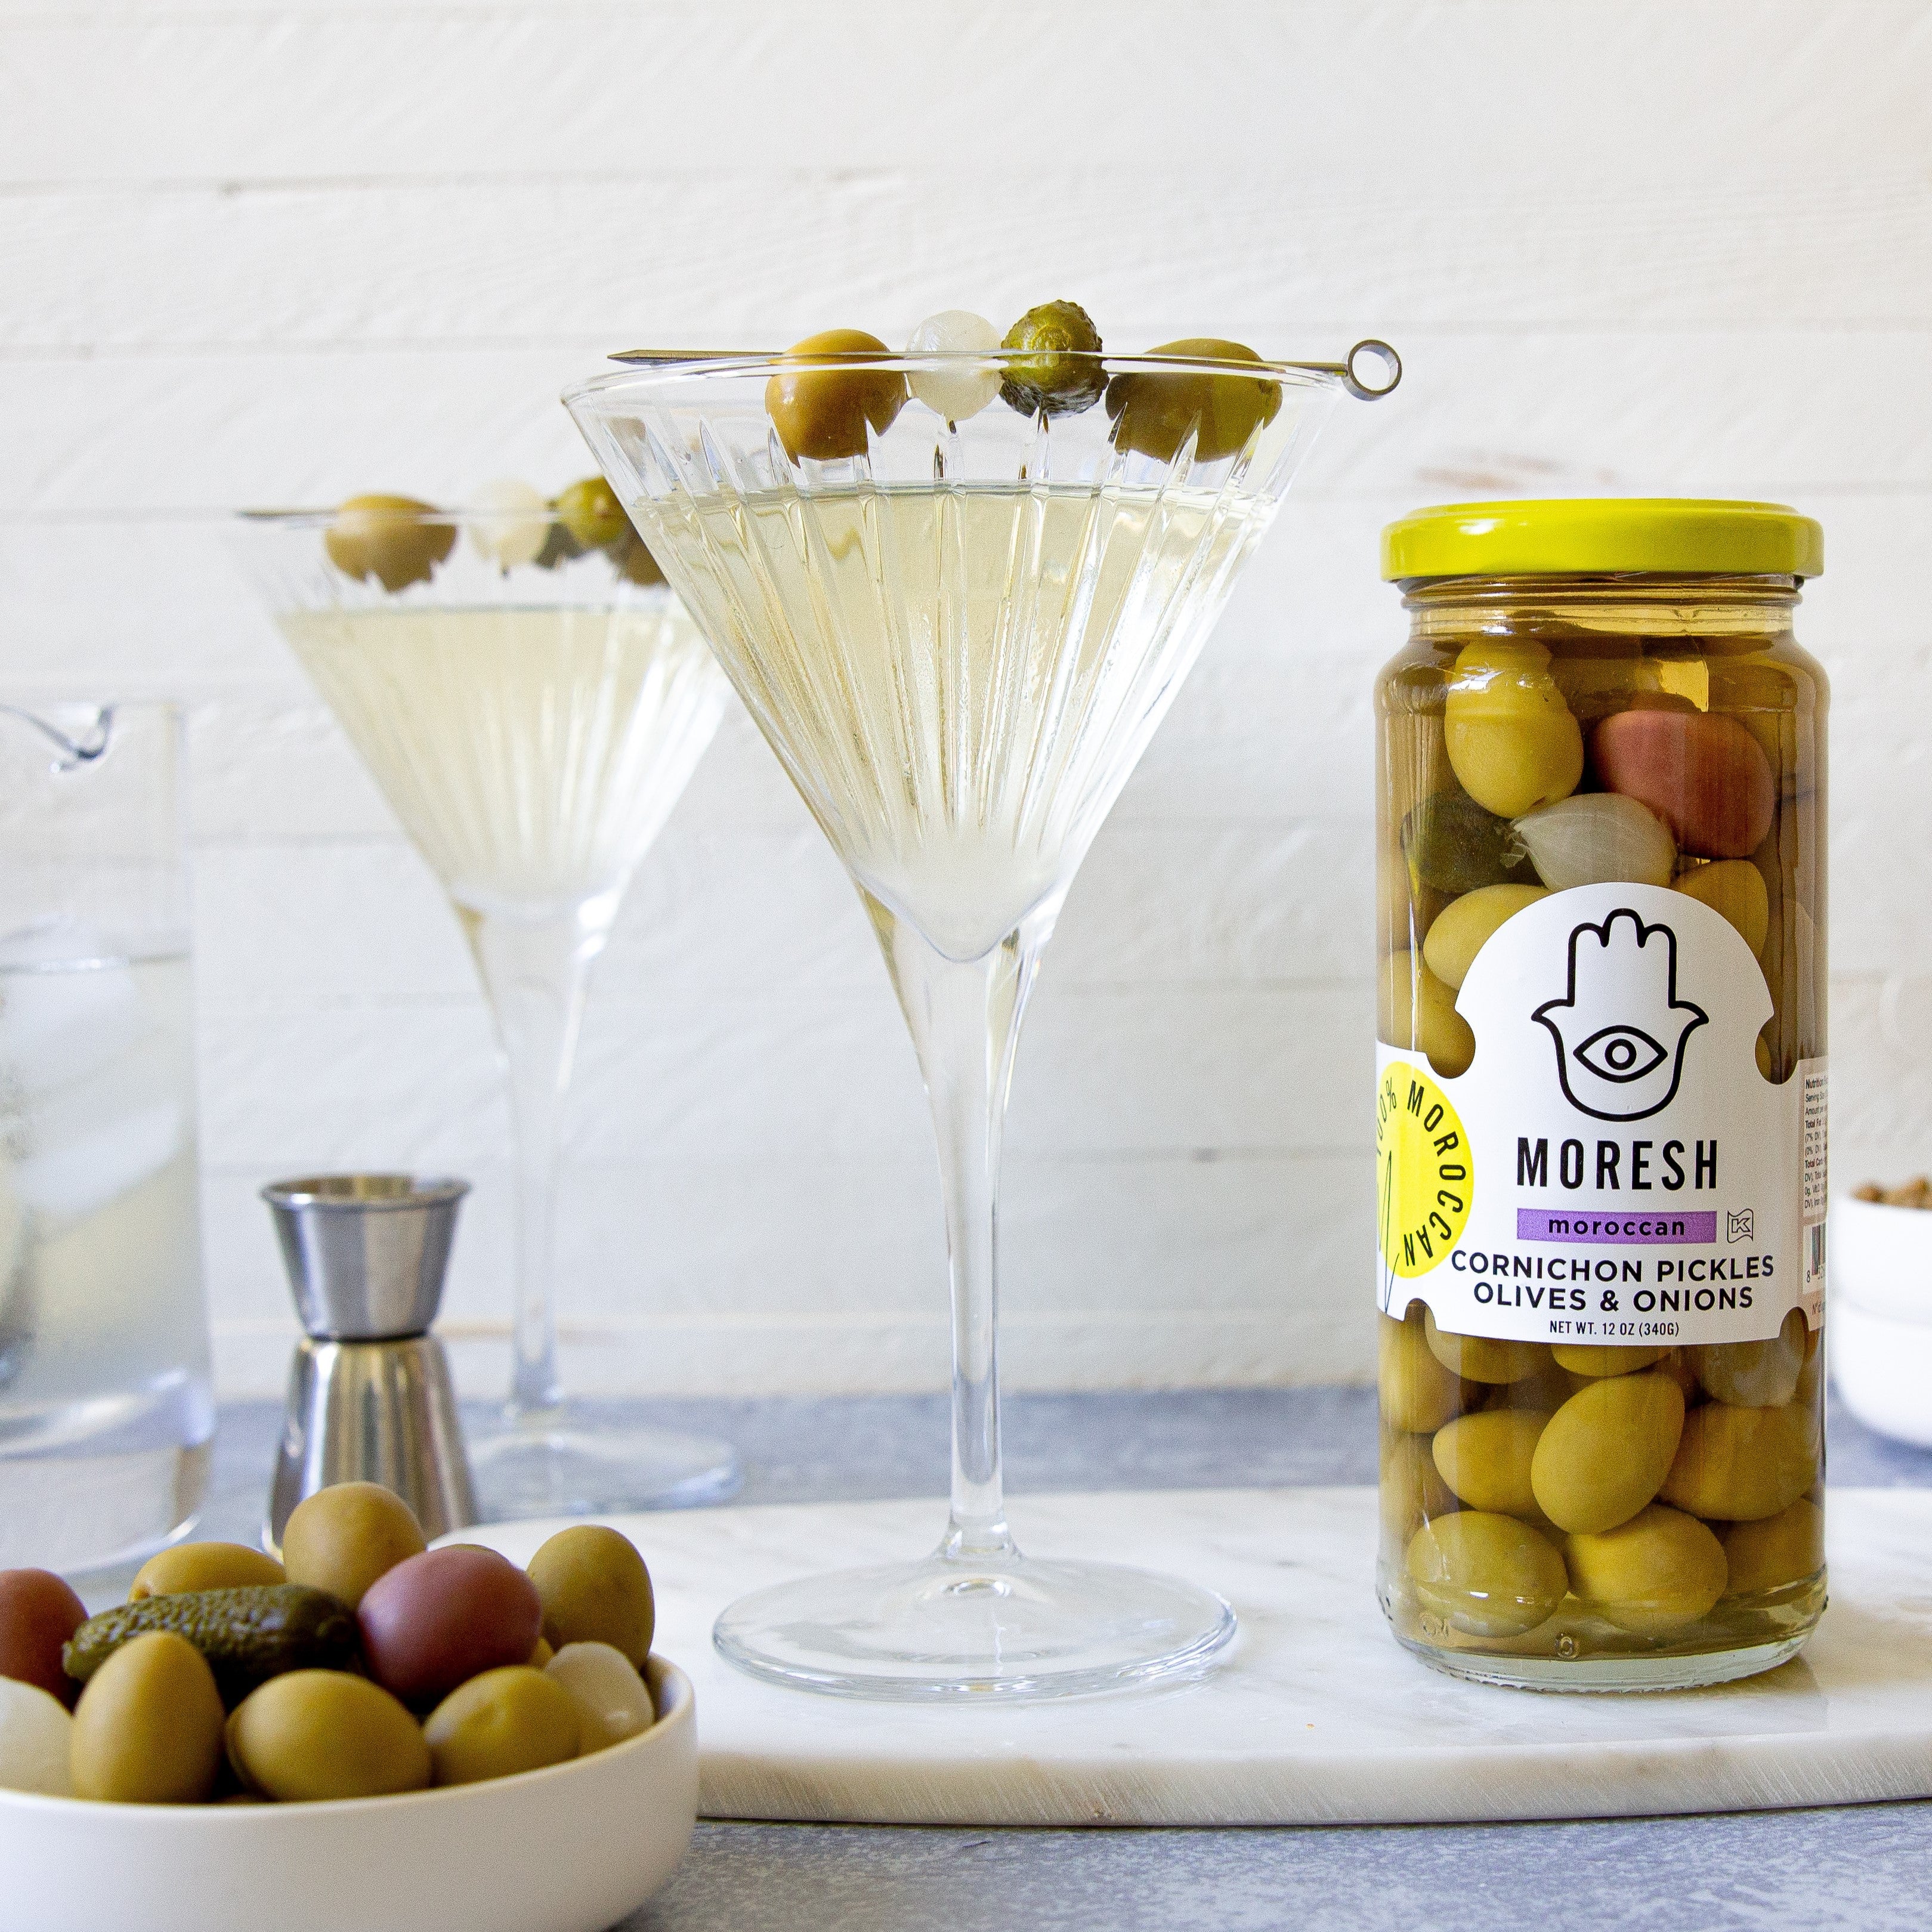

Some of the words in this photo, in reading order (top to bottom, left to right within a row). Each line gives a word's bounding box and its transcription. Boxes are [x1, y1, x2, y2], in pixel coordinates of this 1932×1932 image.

[1805, 1119, 1816, 1129] Total
[1404, 1079, 1466, 1267] MOROCCAN
[1517, 1137, 1718, 1191] MORESH
[1805, 1158, 1815, 1169] Total
[1548, 1219, 1685, 1236] moroccan
[1451, 1250, 1642, 1282] CORNICHON
[1657, 1255, 1775, 1282] PICKLES
[1473, 1282, 1587, 1310] OLIVES
[1600, 1290, 1620, 1312] &
[1633, 1286, 1753, 1312] ONIONS
[1550, 1320, 1572, 1334] NET
[1575, 1321, 1597, 1335] WT.
[1603, 1322, 1615, 1336] 12
[1620, 1322, 1635, 1336] OZ
[1639, 1321, 1680, 1337] (340G)
